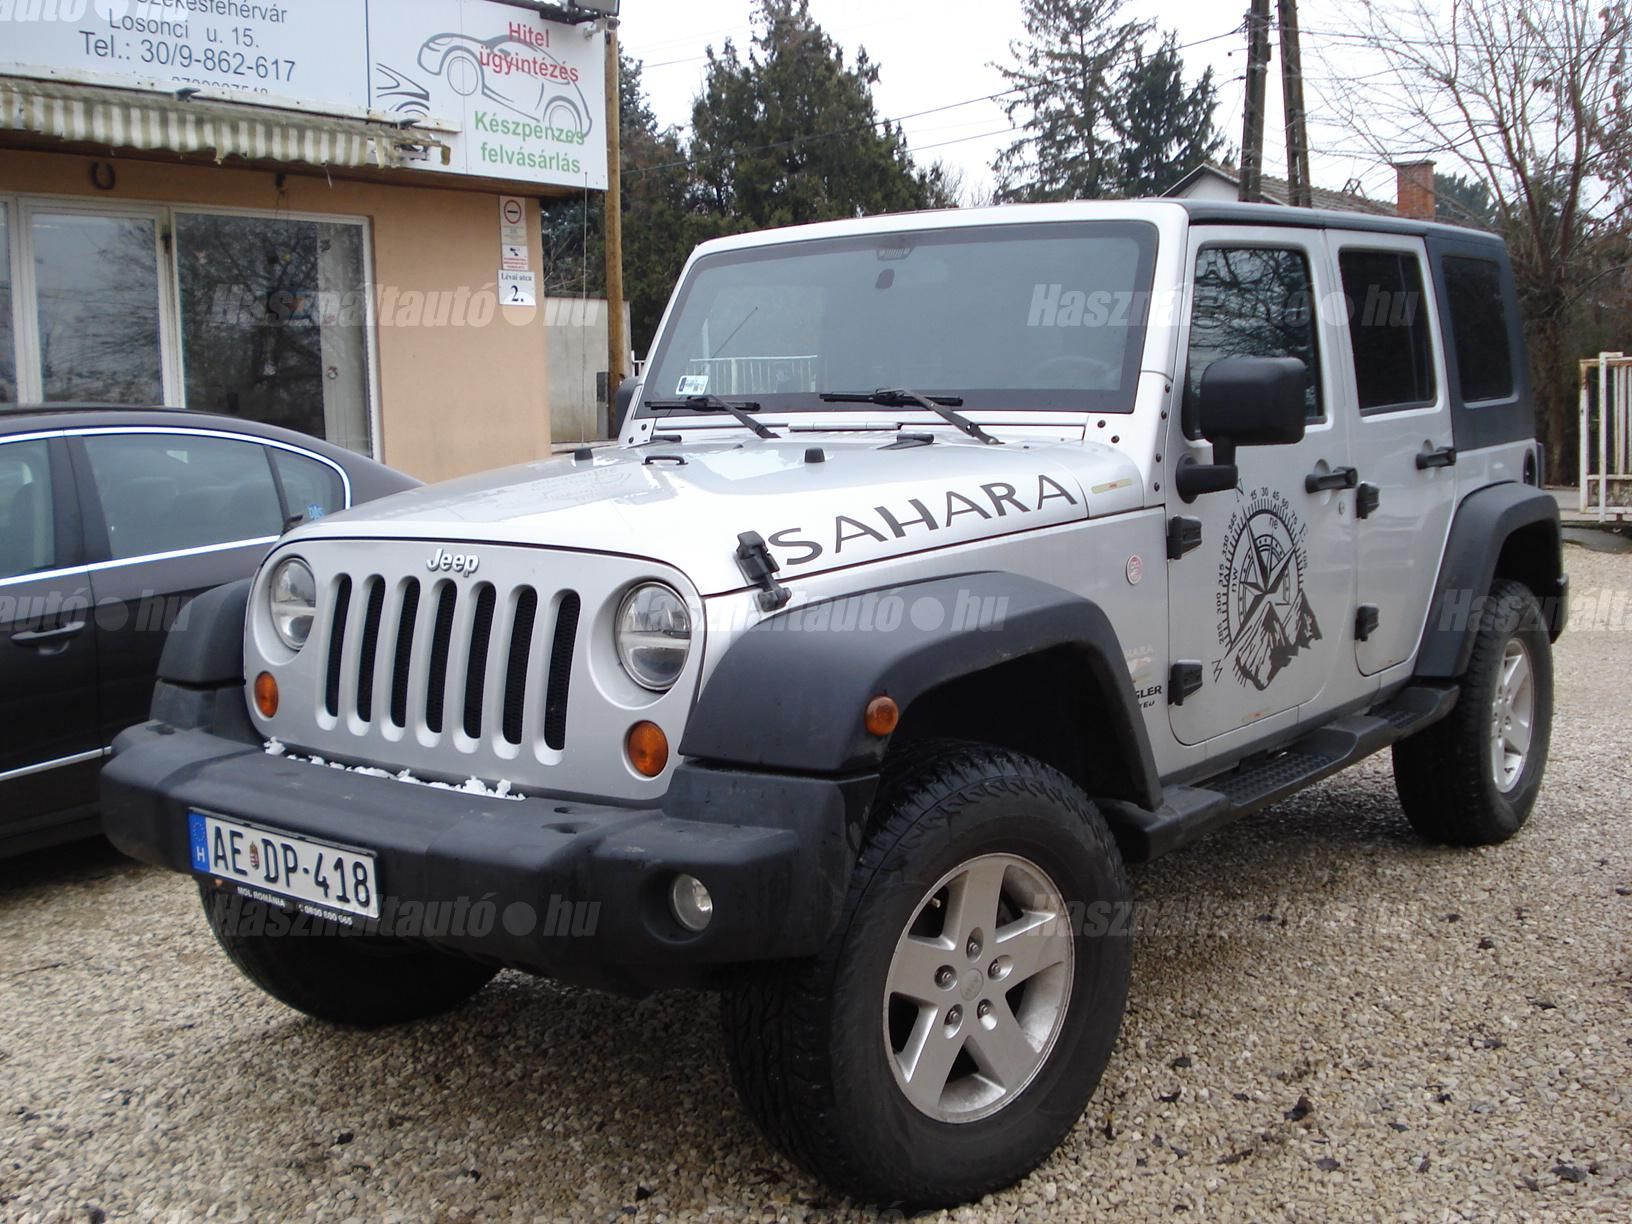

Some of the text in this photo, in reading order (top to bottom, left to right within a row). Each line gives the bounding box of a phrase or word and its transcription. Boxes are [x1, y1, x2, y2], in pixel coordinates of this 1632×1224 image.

[109, 8, 260, 49] Losonci u. 15.
[508, 21, 550, 48] Hitel
[79, 30, 296, 82] Tel.: 30/9-862-617
[479, 46, 579, 82] ügyintézés
[480, 142, 581, 174] felvásárlás
[510, 285, 524, 302] 2.
[768, 474, 1078, 566] SAHARA
[426, 548, 480, 578] Jeep
[196, 846, 206, 863] H
